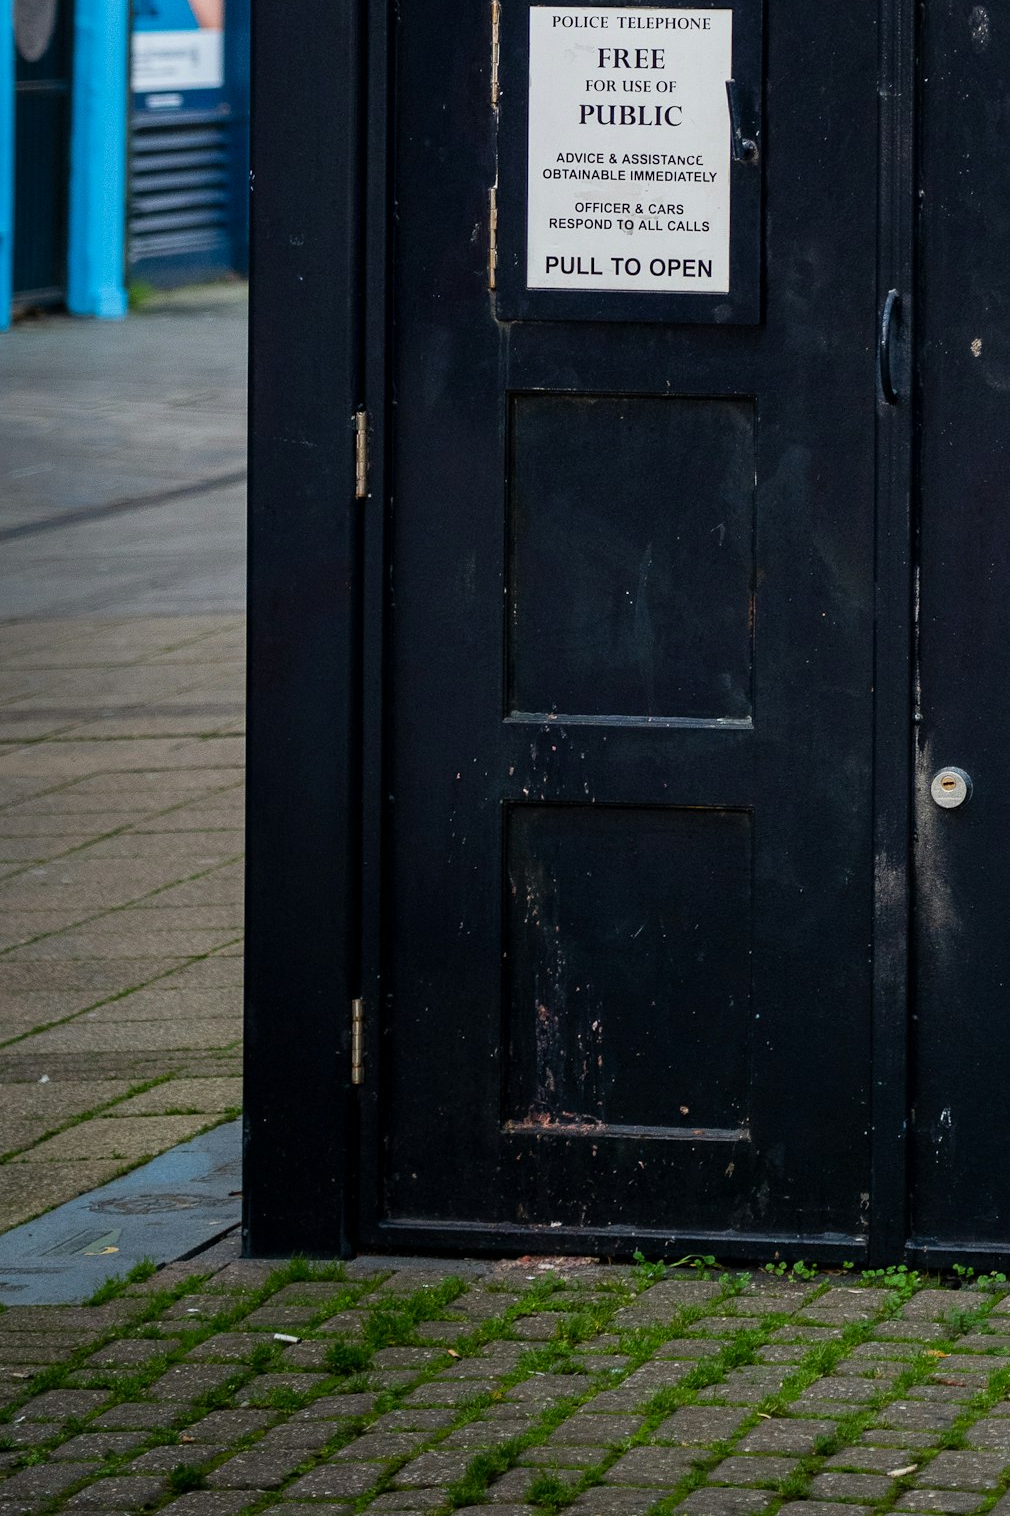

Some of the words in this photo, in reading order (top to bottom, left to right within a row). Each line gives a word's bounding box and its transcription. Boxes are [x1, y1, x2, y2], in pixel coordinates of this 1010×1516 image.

[553, 16, 609, 29] POLICE
[617, 17, 711, 30] TELEPHONE
[597, 48, 665, 69] FREE
[586, 80, 617, 92] FOR
[622, 80, 651, 93] USE
[656, 81, 677, 93] OF
[579, 105, 683, 126] PUBLIC
[557, 153, 607, 164] ADVICE
[609, 154, 618, 164] &
[622, 154, 704, 166] ASSISTANCE
[543, 169, 626, 181] OBTAINABLE
[630, 171, 717, 183] IMMEDIATELY
[575, 203, 631, 214] OFFICER
[636, 204, 644, 214] &
[648, 204, 684, 215] CARS
[549, 219, 612, 230] RESPOND
[618, 220, 634, 230] TO
[639, 220, 663, 231] ALL
[668, 221, 710, 232] CALLS
[546, 257, 603, 275] PULL
[611, 258, 641, 276] TO
[650, 259, 713, 278] OPEN
